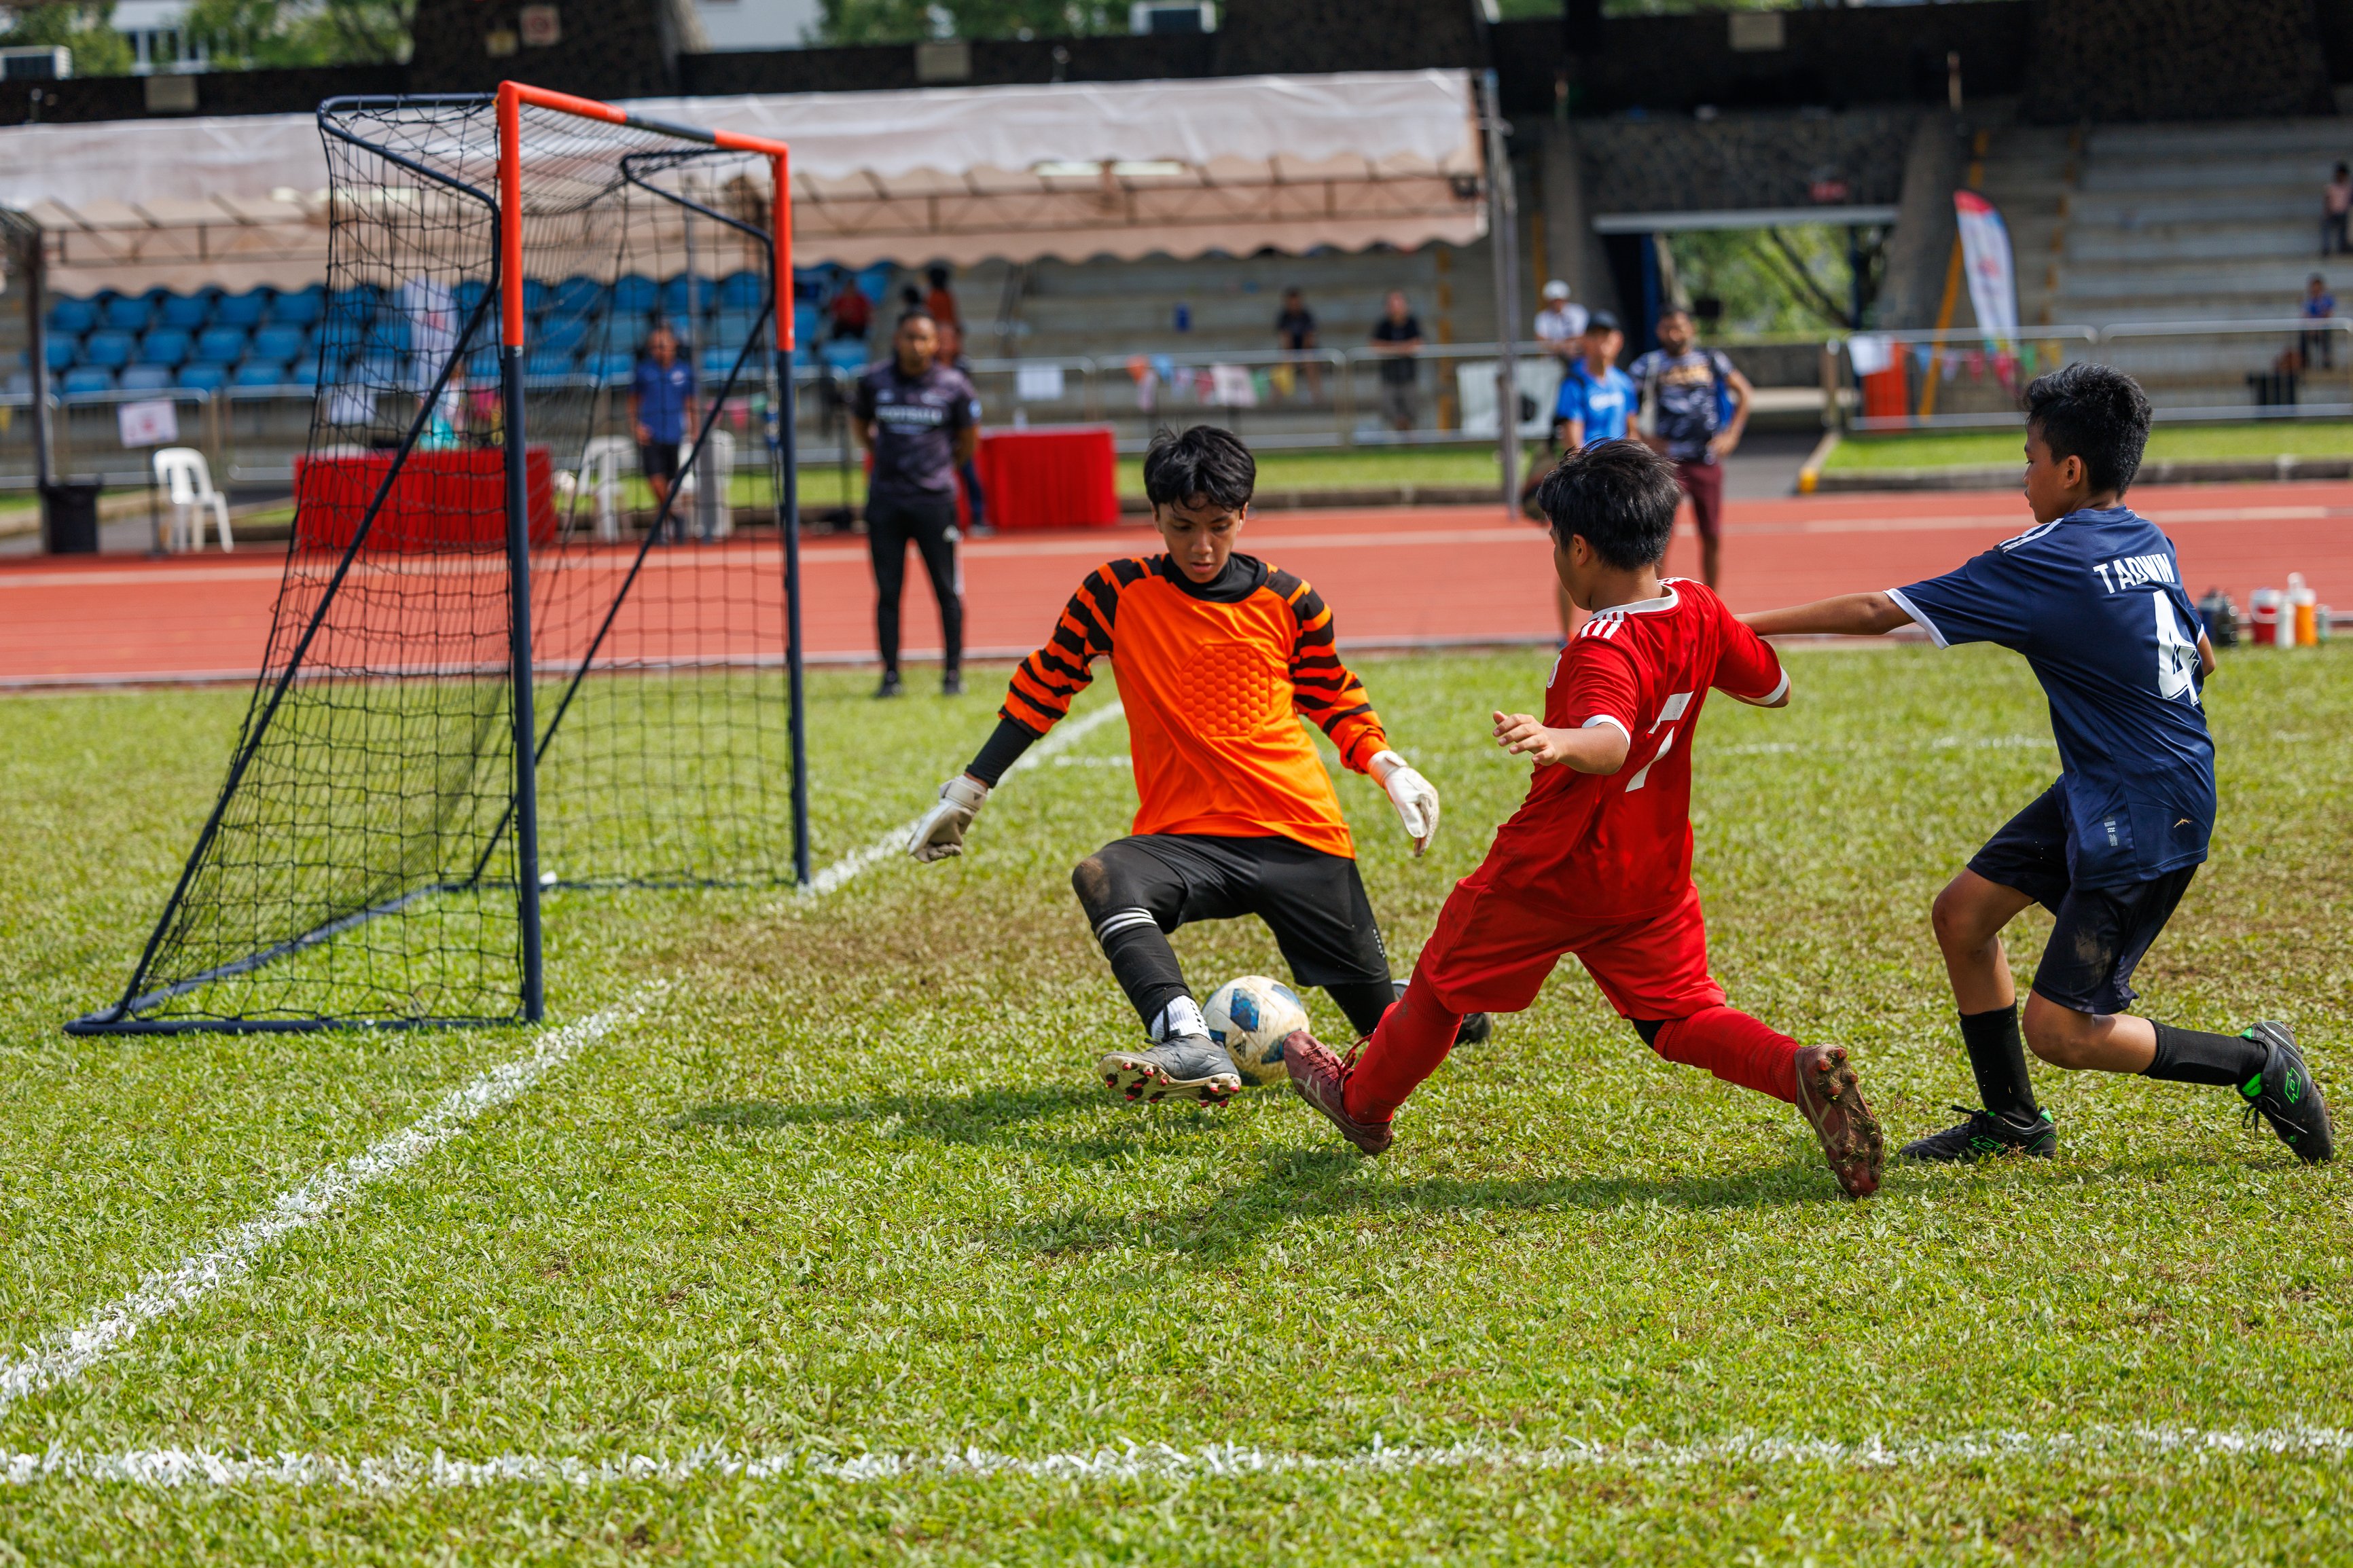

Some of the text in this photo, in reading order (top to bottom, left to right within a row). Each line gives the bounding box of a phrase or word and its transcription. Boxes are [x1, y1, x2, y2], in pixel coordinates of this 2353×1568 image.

[2093, 553, 2175, 594] TADWIN
[2153, 589, 2200, 707] 4
[1625, 691, 1694, 792] 7
